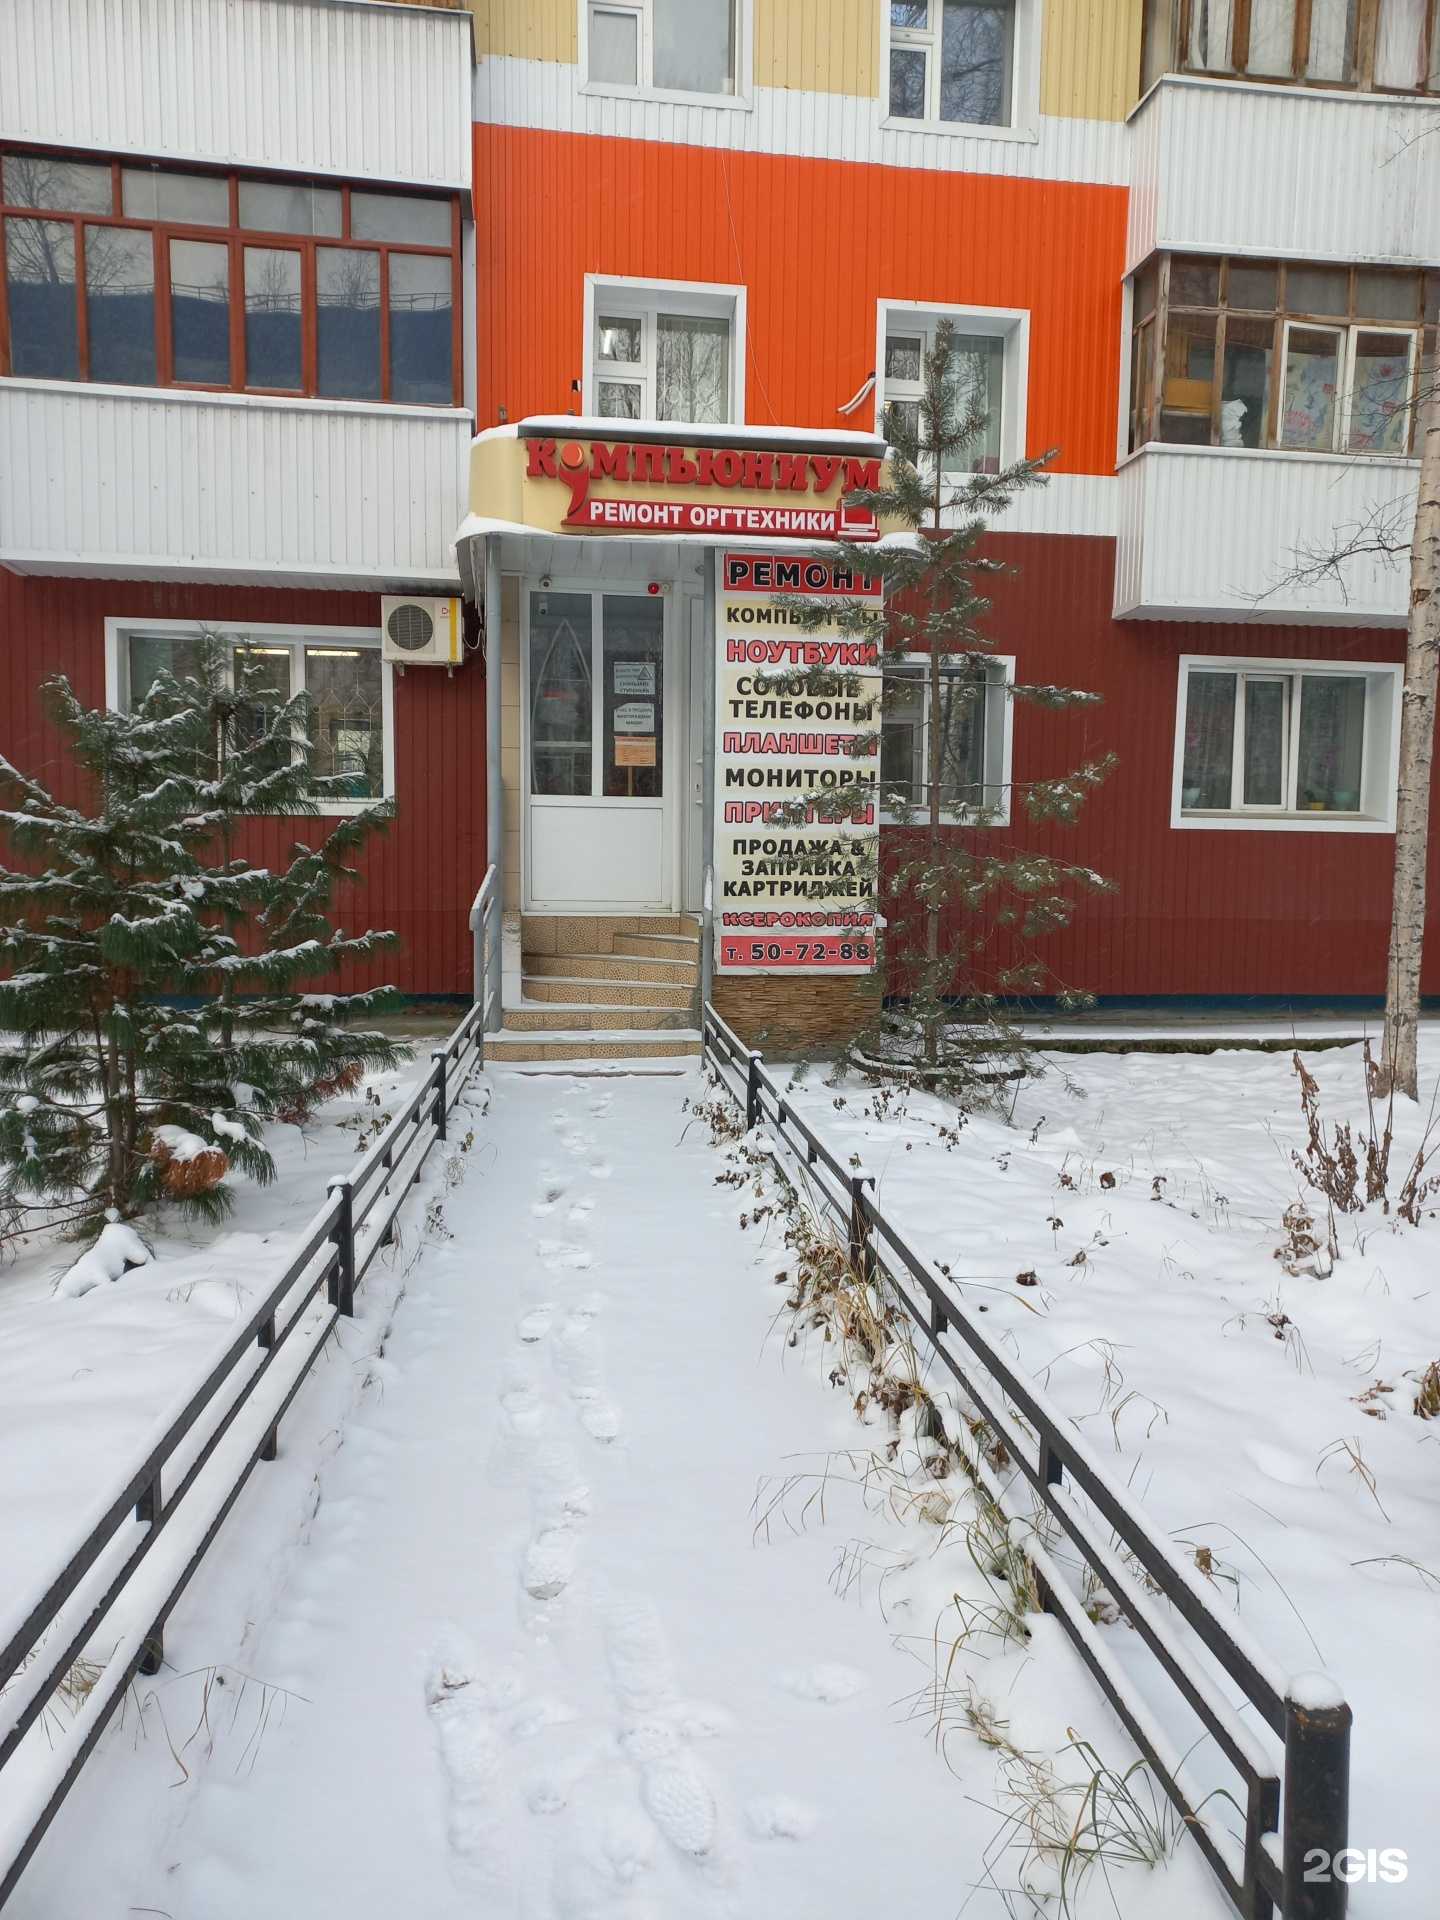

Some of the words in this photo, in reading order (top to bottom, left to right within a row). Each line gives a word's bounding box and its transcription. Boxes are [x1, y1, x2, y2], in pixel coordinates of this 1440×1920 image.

[525, 438, 882, 493] КОМПЬЮНИУМ
[589, 501, 684, 526] РЕМОНТ
[690, 505, 836, 532] ОРГТЕХНИКИ
[726, 639, 878, 665] НОУТБУКИ
[728, 700, 873, 721] ТЕЛЕФОНЫ
[725, 768, 876, 788] МОНИТОРЫ
[733, 839, 842, 858] ПРОДАЖА
[741, 859, 856, 877] ЗАПРАВКА
[723, 878, 873, 900] КАРТРИДЖЕЙ
[722, 911, 875, 928] КСЕРОКОПИЯ
[751, 943, 871, 961] 50-72-88
